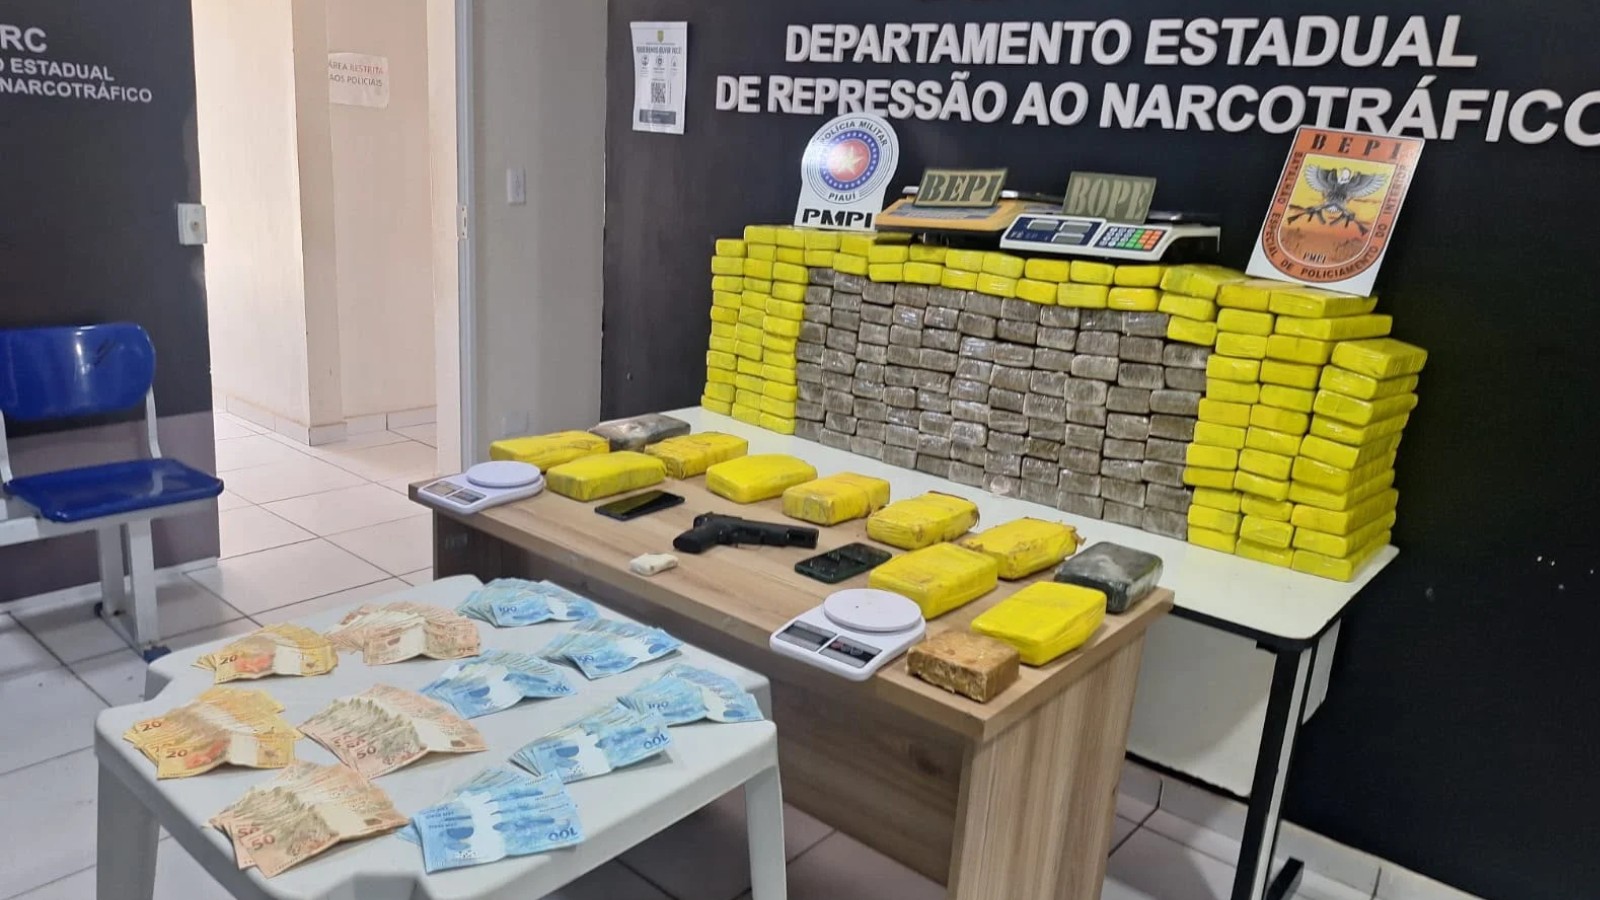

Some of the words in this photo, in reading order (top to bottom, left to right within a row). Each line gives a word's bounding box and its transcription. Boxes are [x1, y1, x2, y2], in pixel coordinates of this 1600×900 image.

[785, 19, 1132, 66] DEPARTAMENTO
[1144, 15, 1478, 67] ESTADUAL
[10, 57, 115, 81] ESTADUAL
[0, 77, 152, 103] NARCOTRÁFICO
[715, 75, 761, 113] DE
[767, 71, 1007, 120] REPRESSÃO
[1012, 81, 1089, 126] AO
[1098, 75, 1600, 147] NARCOTRÁFICO
[859, 121, 888, 146] MILITAR
[1311, 133, 1402, 160] BEPI
[918, 174, 1002, 202] BEPI
[1065, 177, 1152, 219] BOPE
[802, 208, 873, 228] PMPI
[1281, 260, 1292, 271] DE
[1301, 246, 1379, 279] POLICIAMENTO
[1375, 224, 1388, 238] DO
[221, 654, 238, 665] 20
[142, 720, 162, 732] 20
[357, 746, 377, 760] 50
[644, 733, 669, 750] 100
[166, 749, 188, 759] 20
[252, 834, 276, 851] 50
[547, 827, 578, 842] 100
